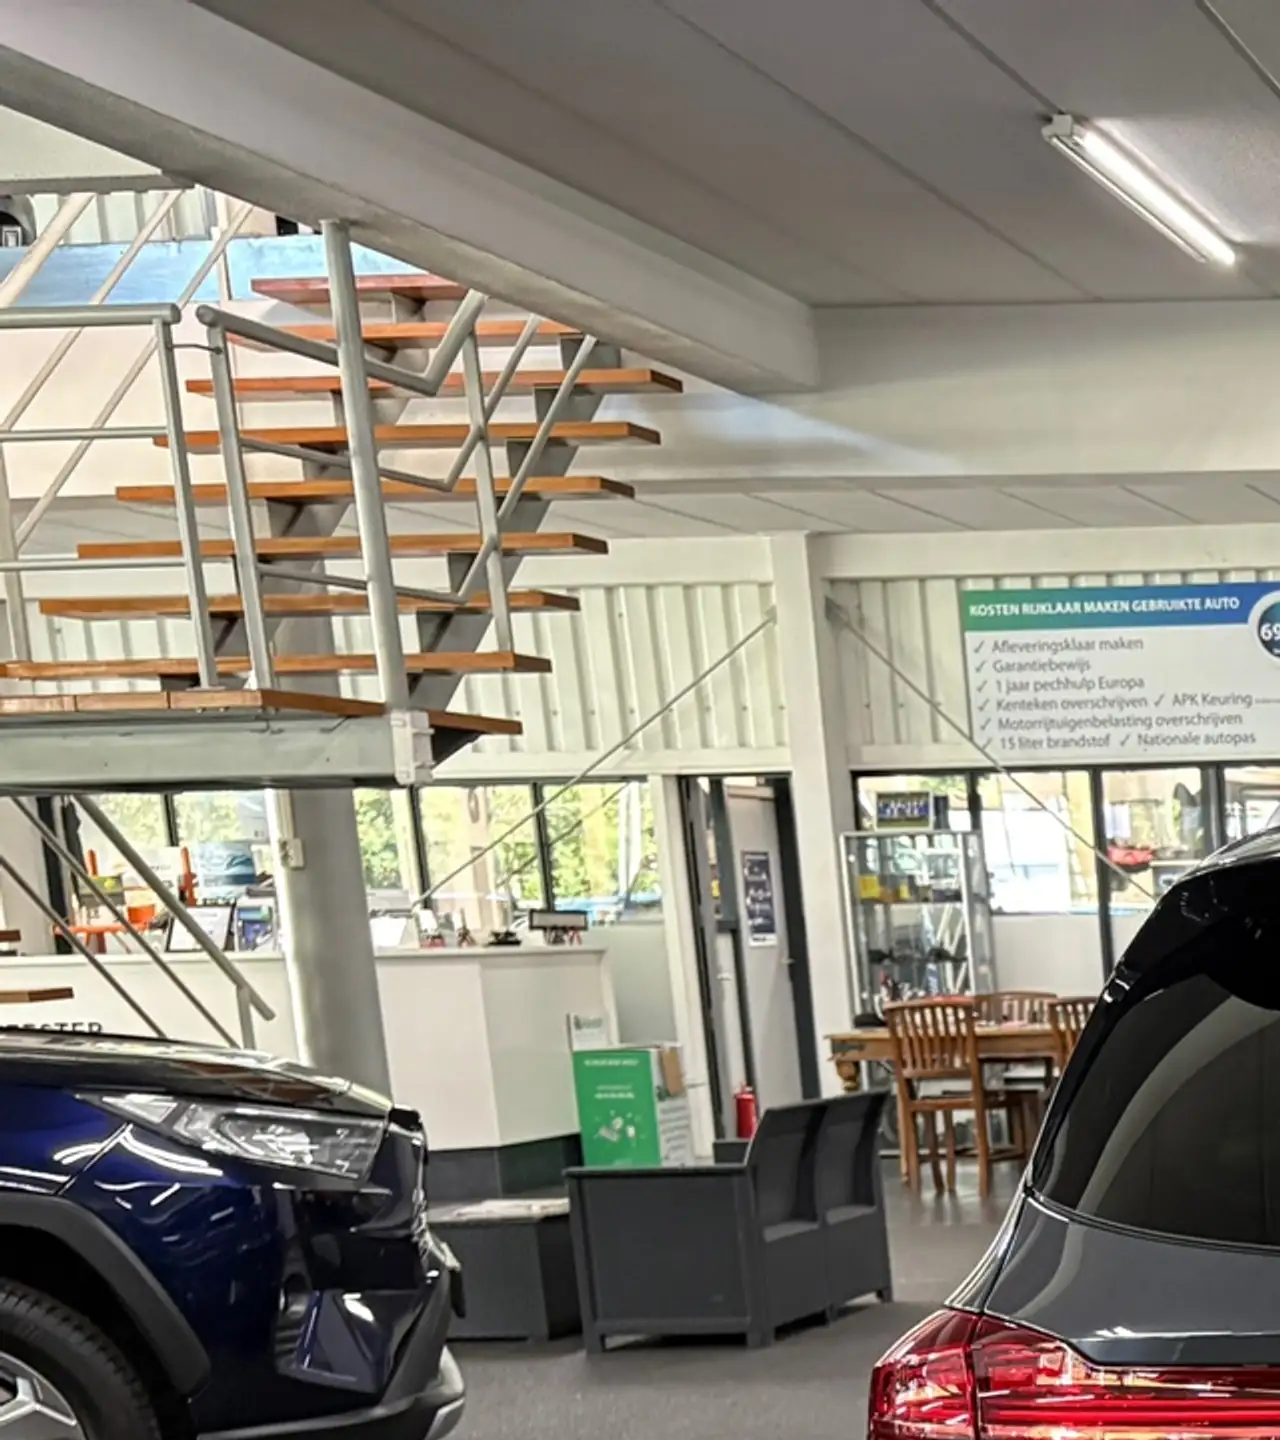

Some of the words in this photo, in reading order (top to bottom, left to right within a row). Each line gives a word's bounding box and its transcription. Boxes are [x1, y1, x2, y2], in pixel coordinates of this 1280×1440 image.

[969, 604, 1020, 617] KOSTEN
[1022, 602, 1082, 616] RIJKLAAR
[1084, 600, 1129, 614] MAKEN
[1132, 598, 1201, 612] GEBRUIKTE
[1204, 597, 1240, 610] AUTO
[992, 637, 1095, 655] Afleveringsklaar
[1098, 636, 1144, 650] maken
[992, 658, 1091, 674] Garantiebewijs
[1005, 679, 1030, 695] jaar
[1033, 677, 1096, 694] pechhulp
[1098, 676, 1145, 692] Europa
[996, 697, 1058, 711] Kenteken
[1061, 696, 1148, 711] overschrijven
[1172, 693, 1199, 706] APK
[1202, 692, 1253, 708] Keuring
[998, 715, 1153, 732] Motorrijtuigenbelasting
[1155, 712, 1243, 728] overschrijven
[1000, 737, 1016, 750] 15
[1047, 734, 1110, 748] brandstof
[1138, 732, 1201, 746] Nationale
[1203, 732, 1257, 747] autopas
